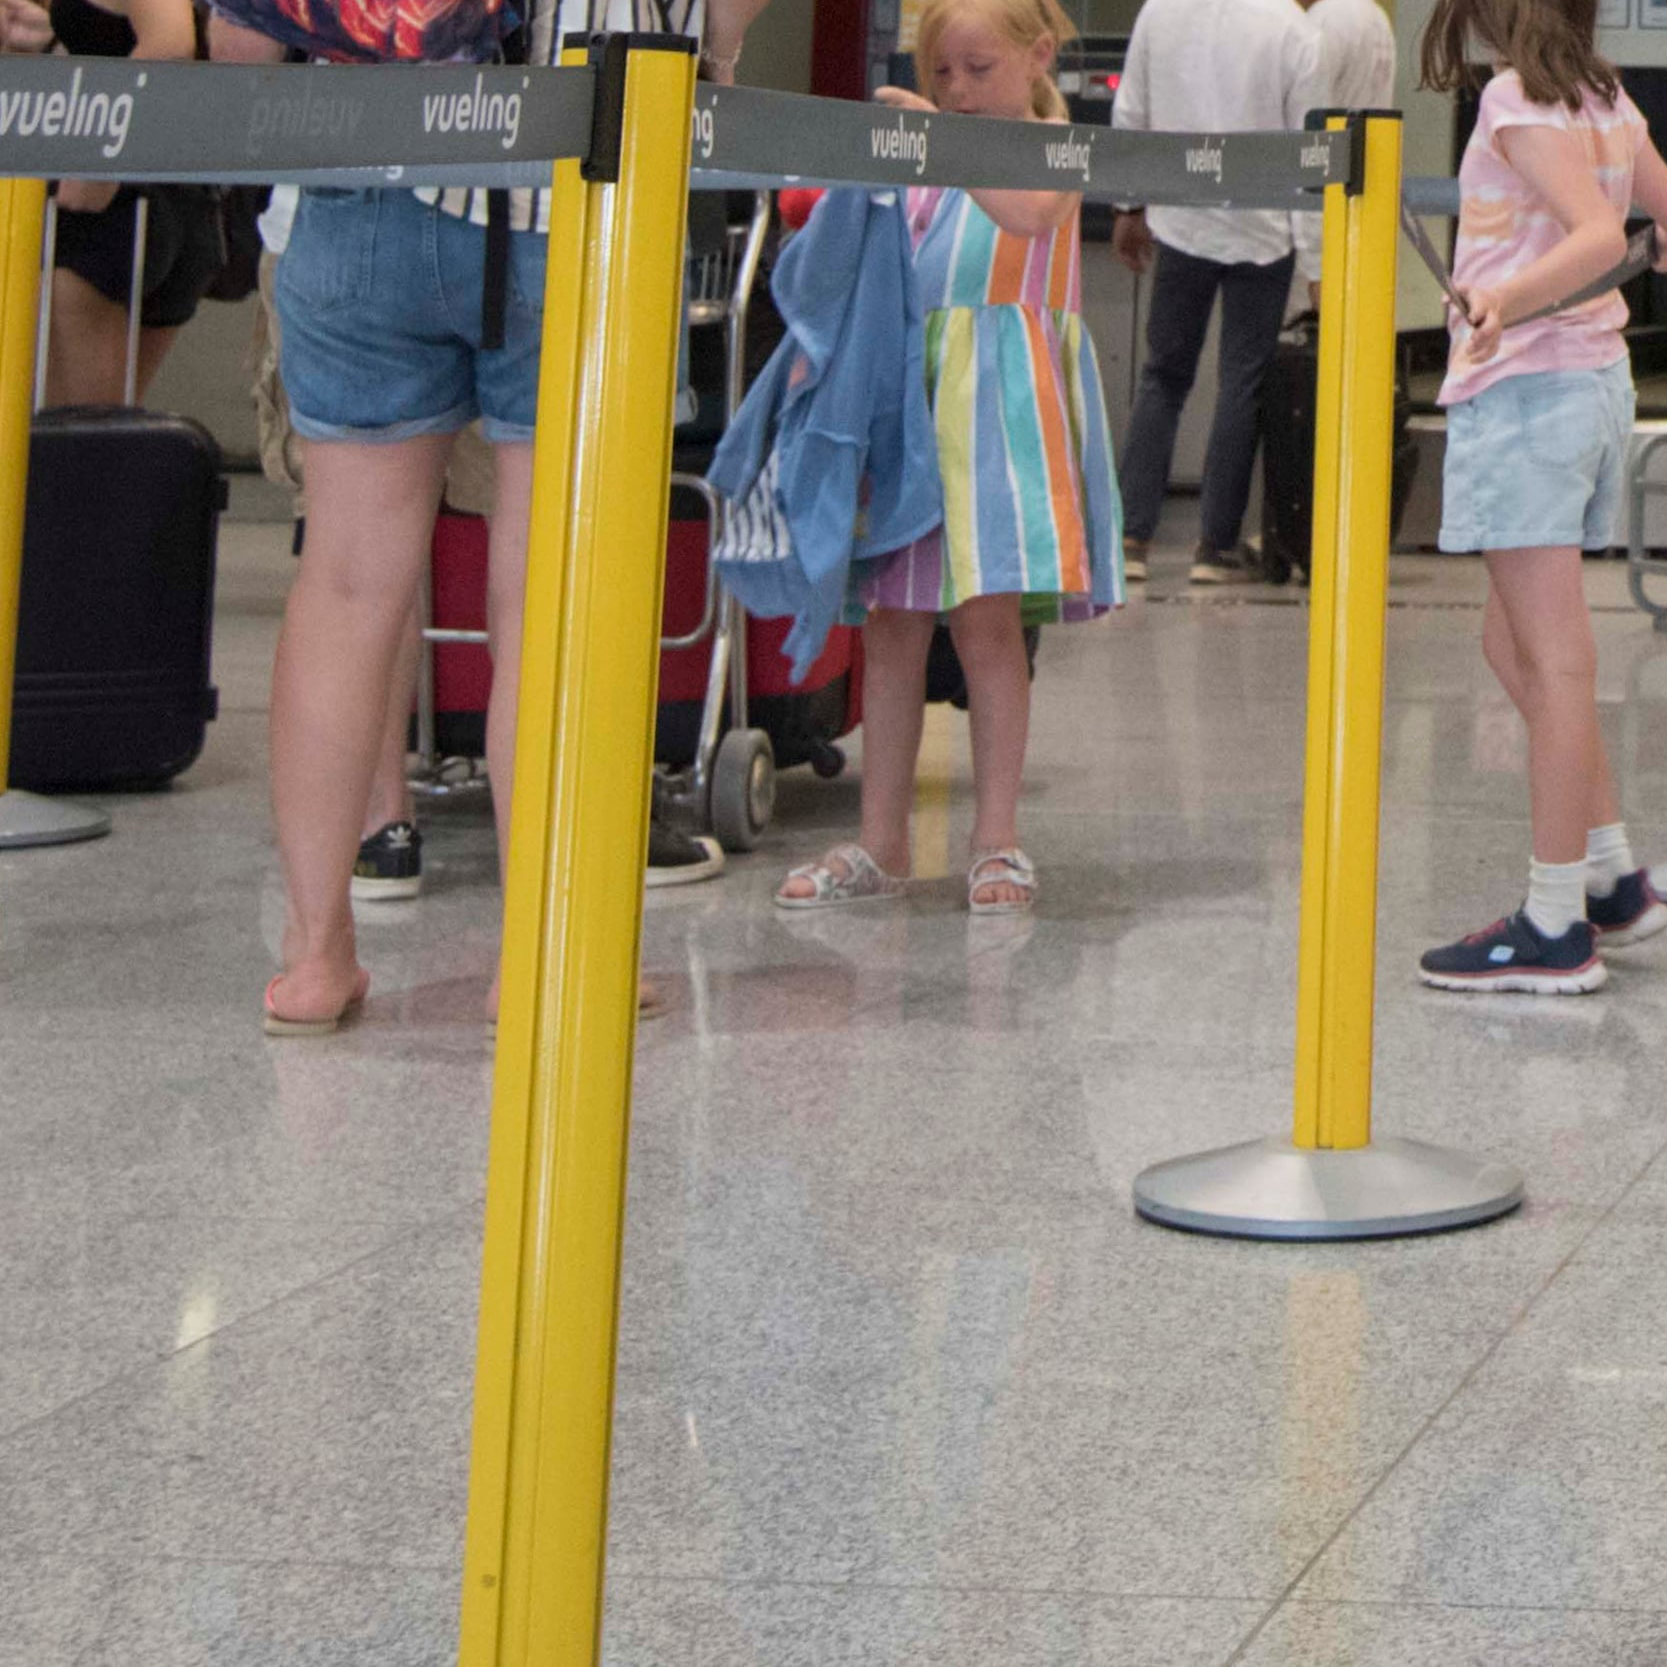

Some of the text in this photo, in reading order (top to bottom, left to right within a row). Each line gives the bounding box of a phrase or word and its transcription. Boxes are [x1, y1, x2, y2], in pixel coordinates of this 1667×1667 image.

[0, 68, 140, 158] vueling
[422, 72, 525, 149] vueling
[870, 113, 929, 175] vueling
[1045, 129, 1093, 182] vueling
[1185, 136, 1224, 184] vueling
[1300, 135, 1332, 177] vueling
